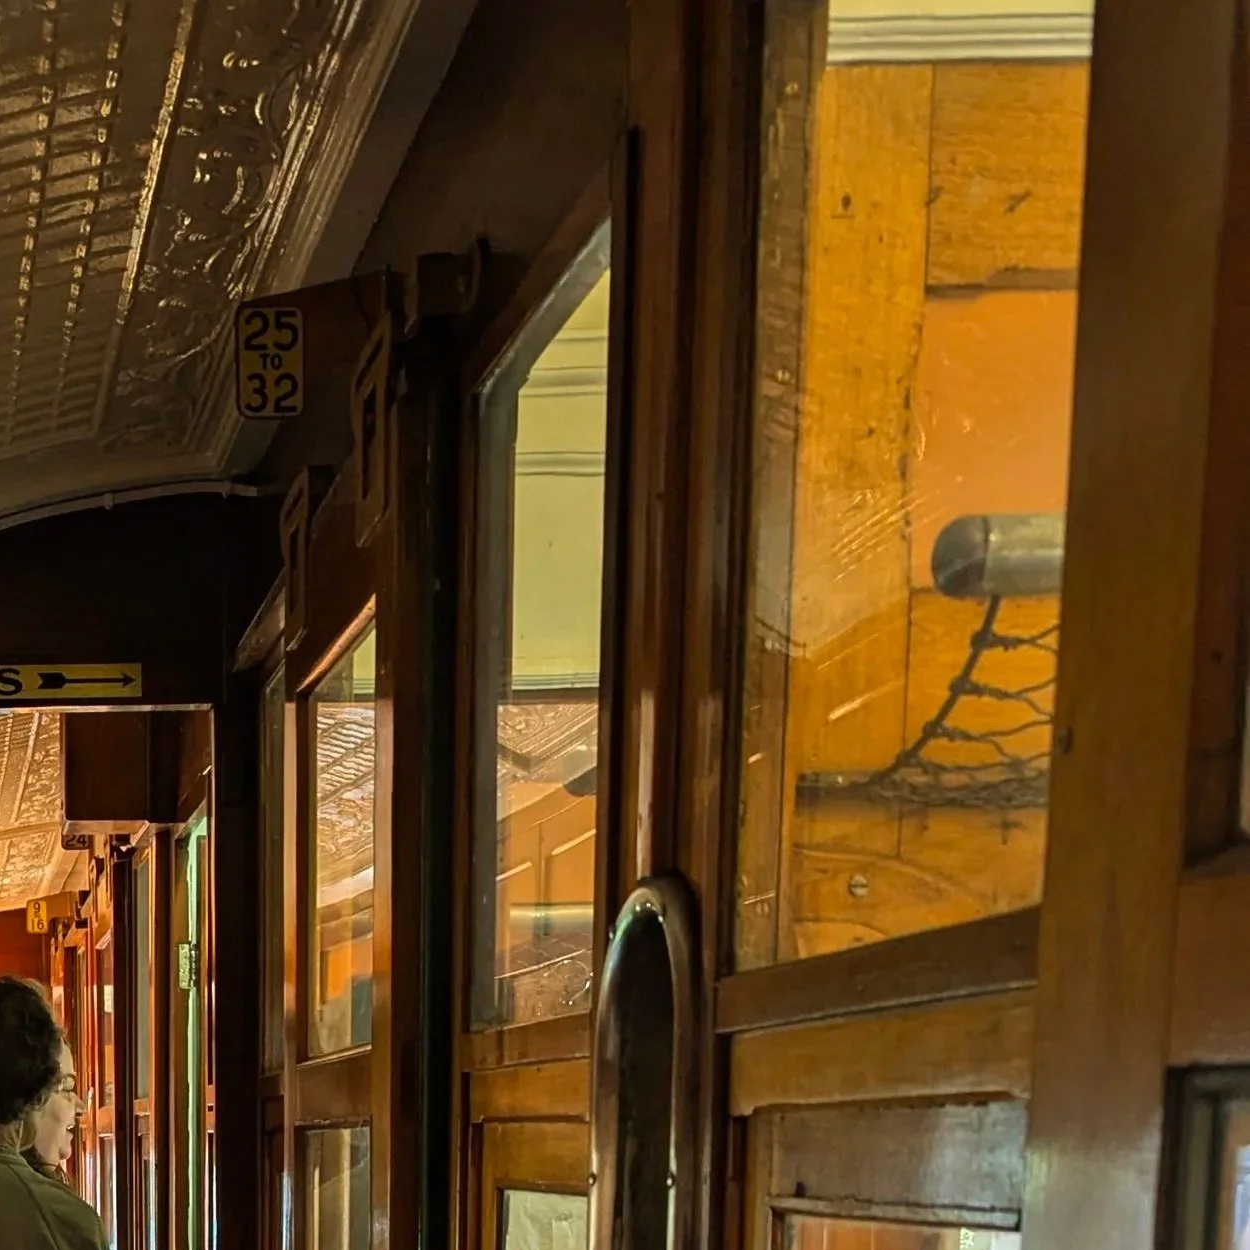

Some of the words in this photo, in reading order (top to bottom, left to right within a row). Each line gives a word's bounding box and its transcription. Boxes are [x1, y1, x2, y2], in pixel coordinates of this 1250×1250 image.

[244, 311, 299, 351] 25
[259, 353, 283, 370] TO
[245, 372, 299, 413] 32
[65, 834, 87, 847] 24
[33, 901, 41, 913] 9
[31, 918, 44, 931] 16
